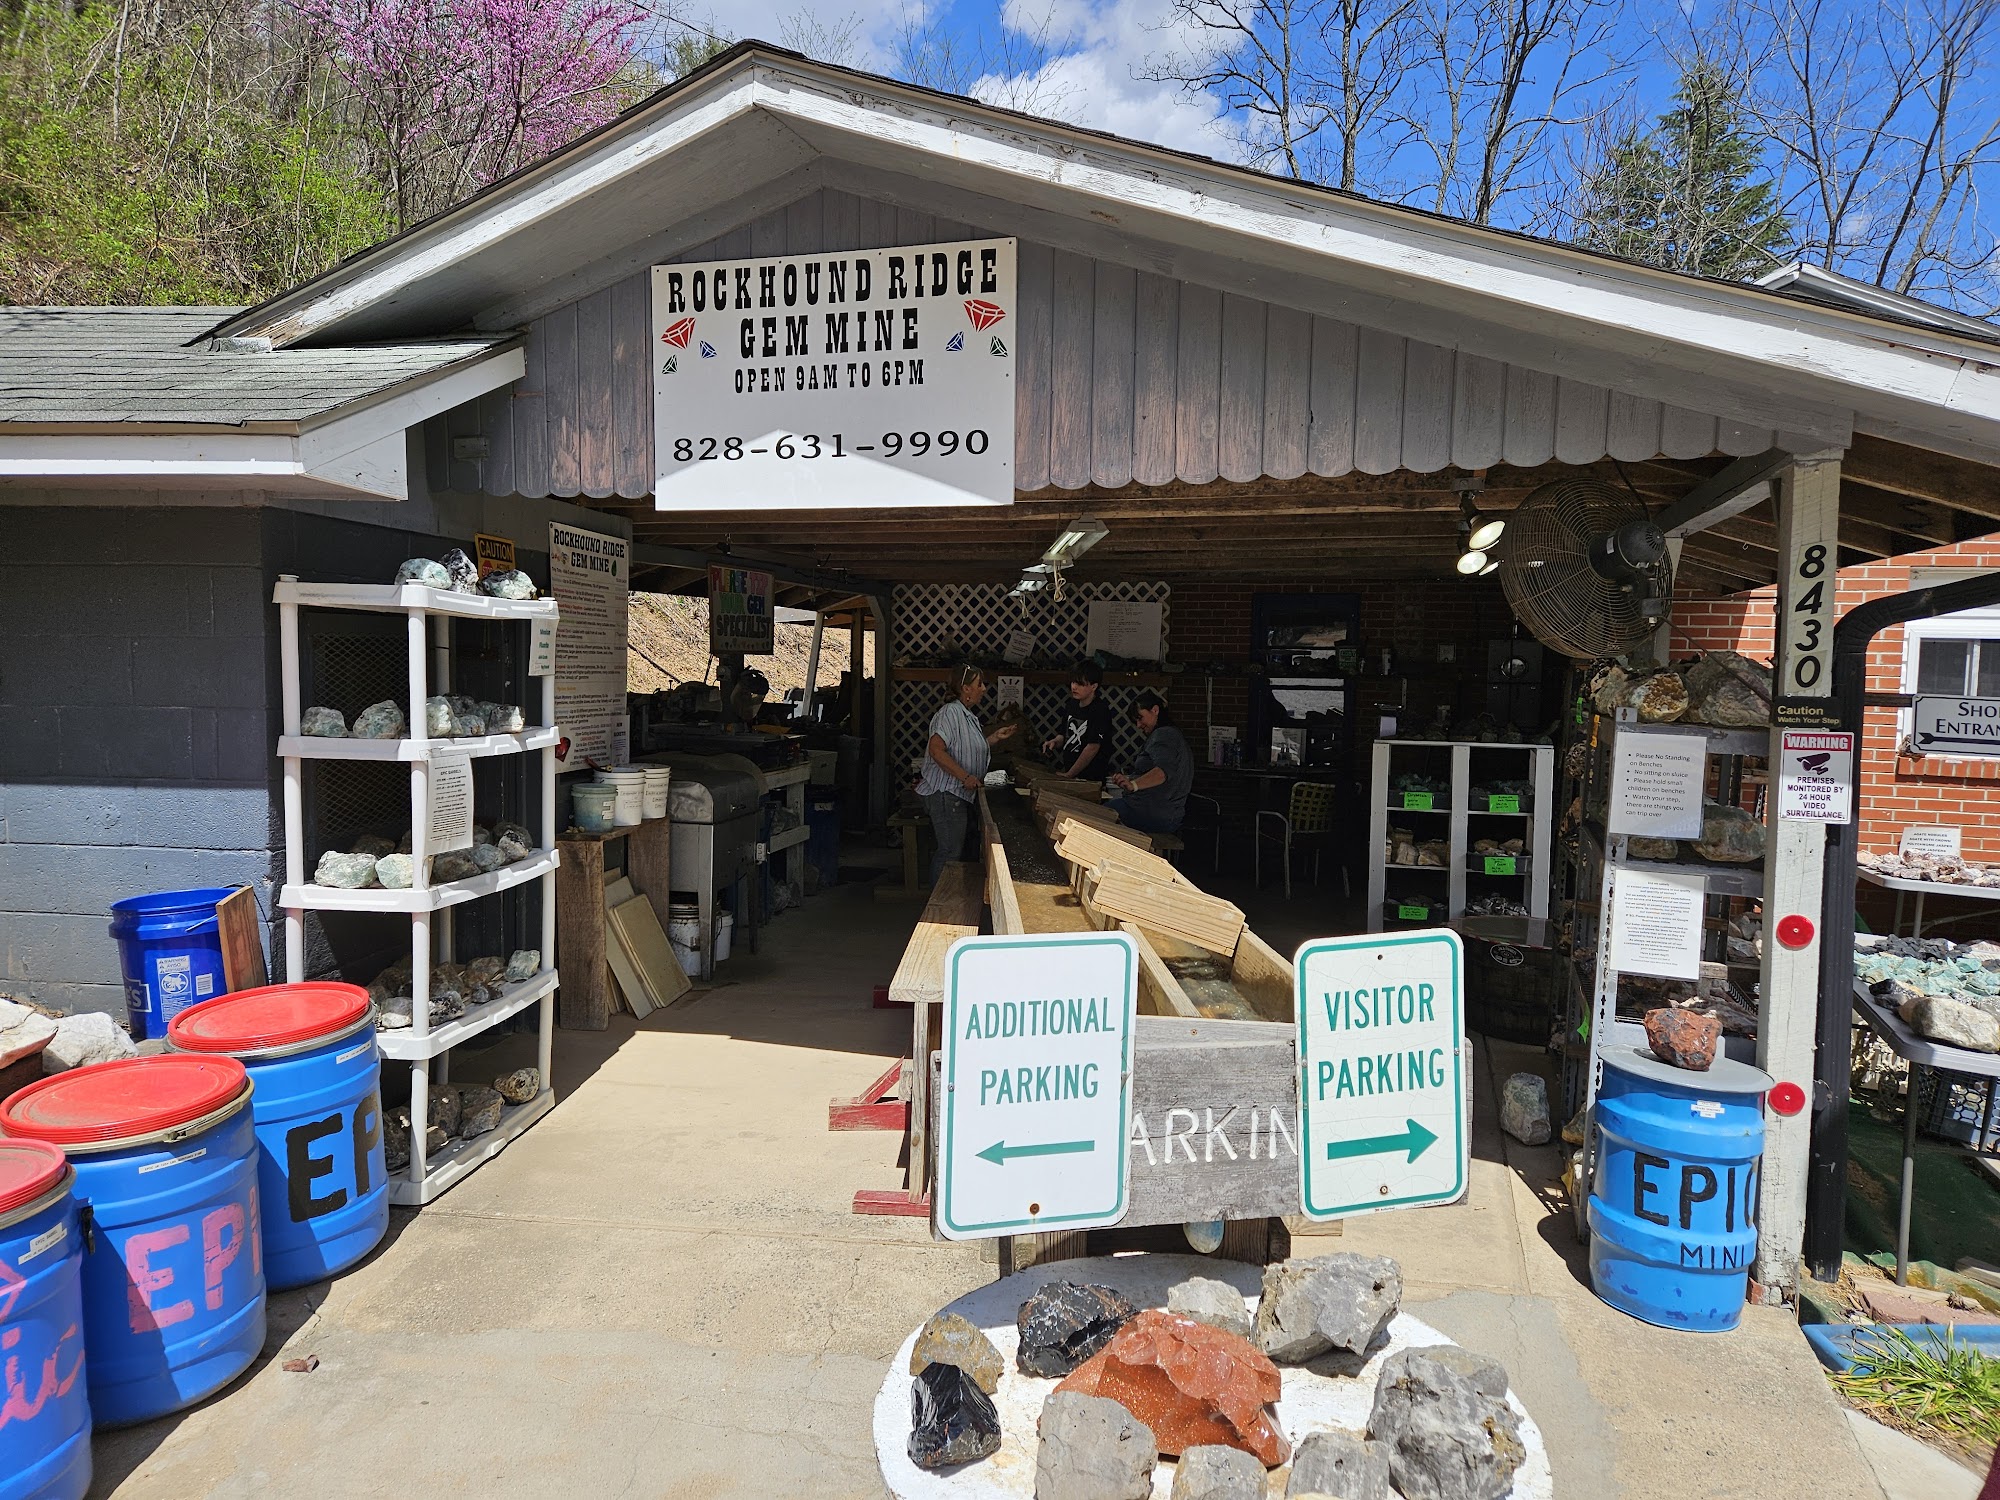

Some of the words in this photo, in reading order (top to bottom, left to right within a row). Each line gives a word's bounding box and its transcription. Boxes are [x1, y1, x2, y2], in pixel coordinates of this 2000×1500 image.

[668, 258, 872, 314] ROCKHOUND
[888, 248, 997, 299] RIDGE
[740, 314, 809, 359] GEM
[825, 307, 919, 354] MINE
[735, 367, 787, 393] OPEN
[796, 364, 838, 391] 9AM
[847, 361, 871, 388] TO
[882, 359, 925, 386] 6PM
[672, 429, 990, 462] 828-631-9990
[479, 540, 513, 562] CAUTION
[553, 528, 600, 553] ROCKHOUND
[602, 540, 625, 558] RIDGE
[571, 551, 588, 569] GEM
[590, 555, 610, 573] MINE
[710, 567, 747, 594] PLEASE
[716, 614, 771, 639] SPECIALIST
[1794, 544, 1827, 689] 8430
[1777, 705, 1824, 715] Caution
[1822, 717, 1840, 725] Step
[1958, 701, 2000, 718] SHO
[1786, 736, 1849, 750] WARNING
[1787, 785, 1832, 793] MONITORED
[1833, 786, 1844, 794] BY
[1797, 776, 1835, 785] PREMISES
[1803, 801, 1826, 810] VIDEO
[965, 997, 1116, 1040] ADDITIONAL
[1324, 983, 1436, 1032] VISITOR
[980, 1062, 1099, 1106] PARKING
[1318, 1048, 1445, 1101] PARKING
[1131, 1104, 1298, 1166] ARKIN
[286, 1092, 381, 1224] EP
[125, 1187, 261, 1335] EPI
[1680, 1242, 1745, 1270] MINI
